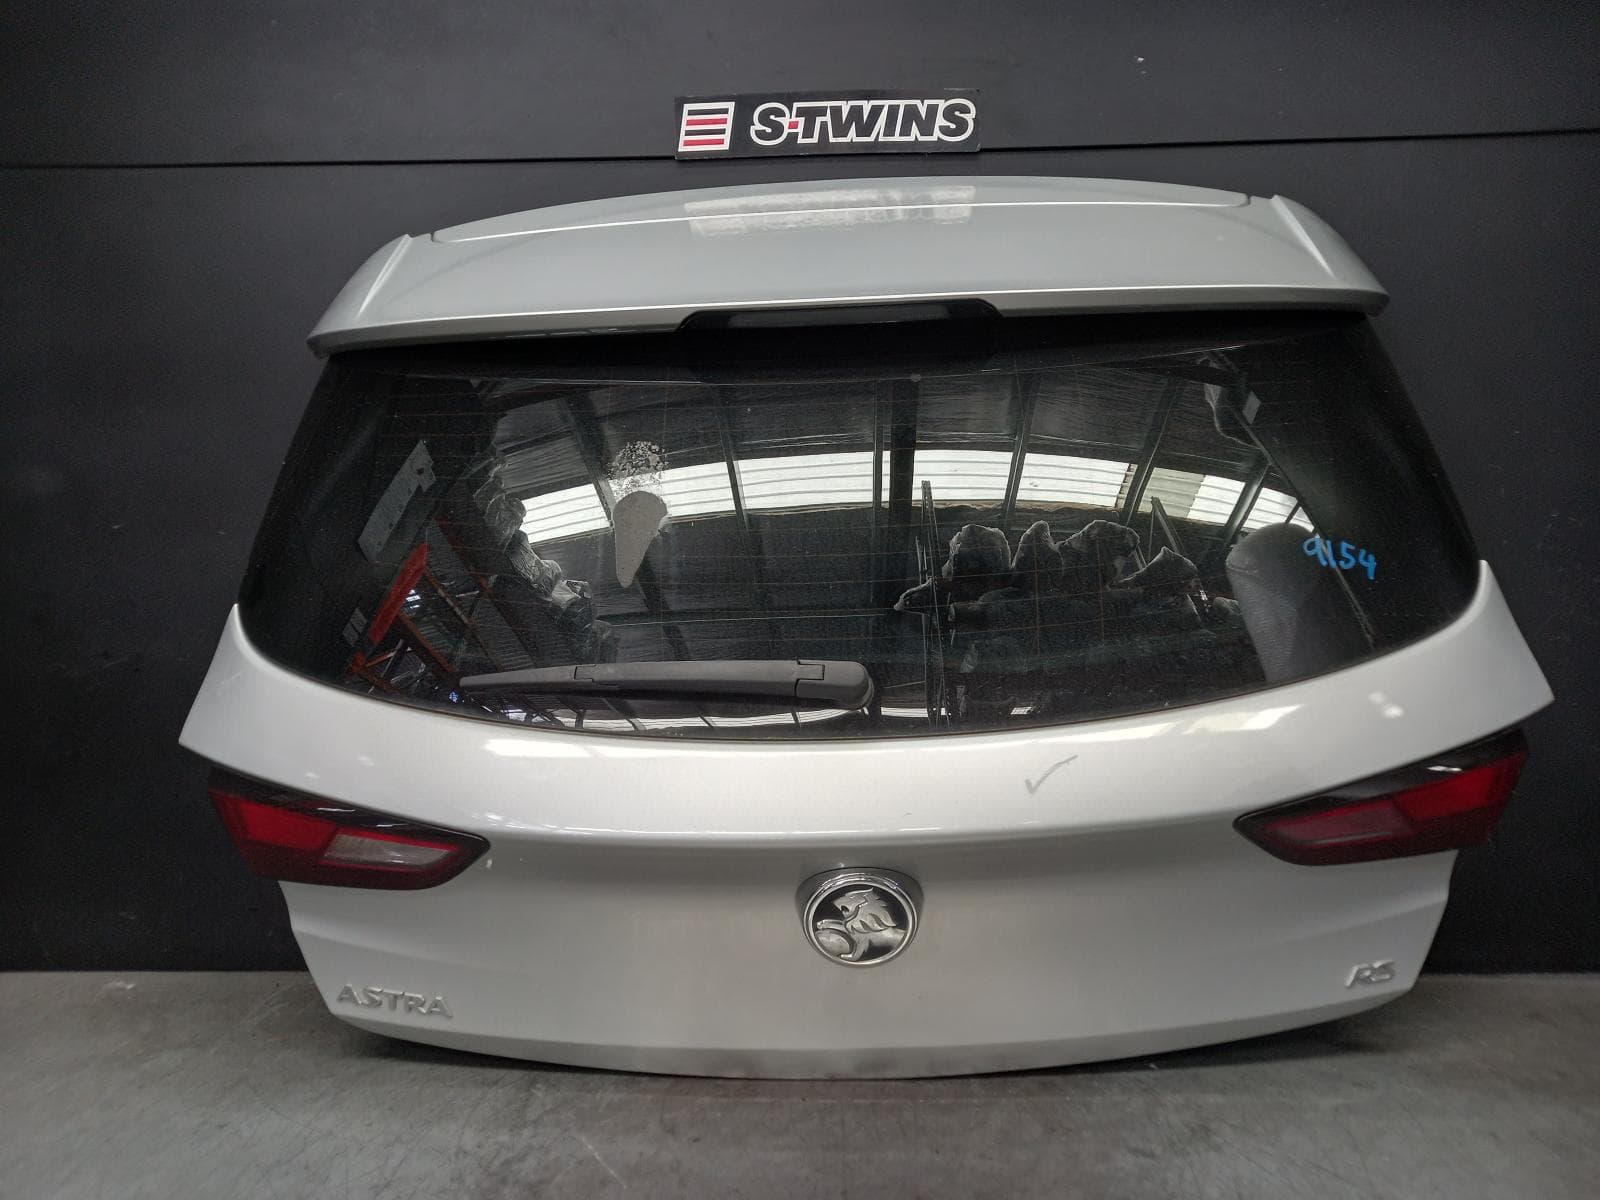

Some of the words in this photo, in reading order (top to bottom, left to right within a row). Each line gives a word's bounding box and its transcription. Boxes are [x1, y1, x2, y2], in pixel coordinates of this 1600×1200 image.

[1302, 534, 1377, 580] 9154
[1343, 958, 1396, 989] RS
[335, 983, 454, 1019] ASTRA
